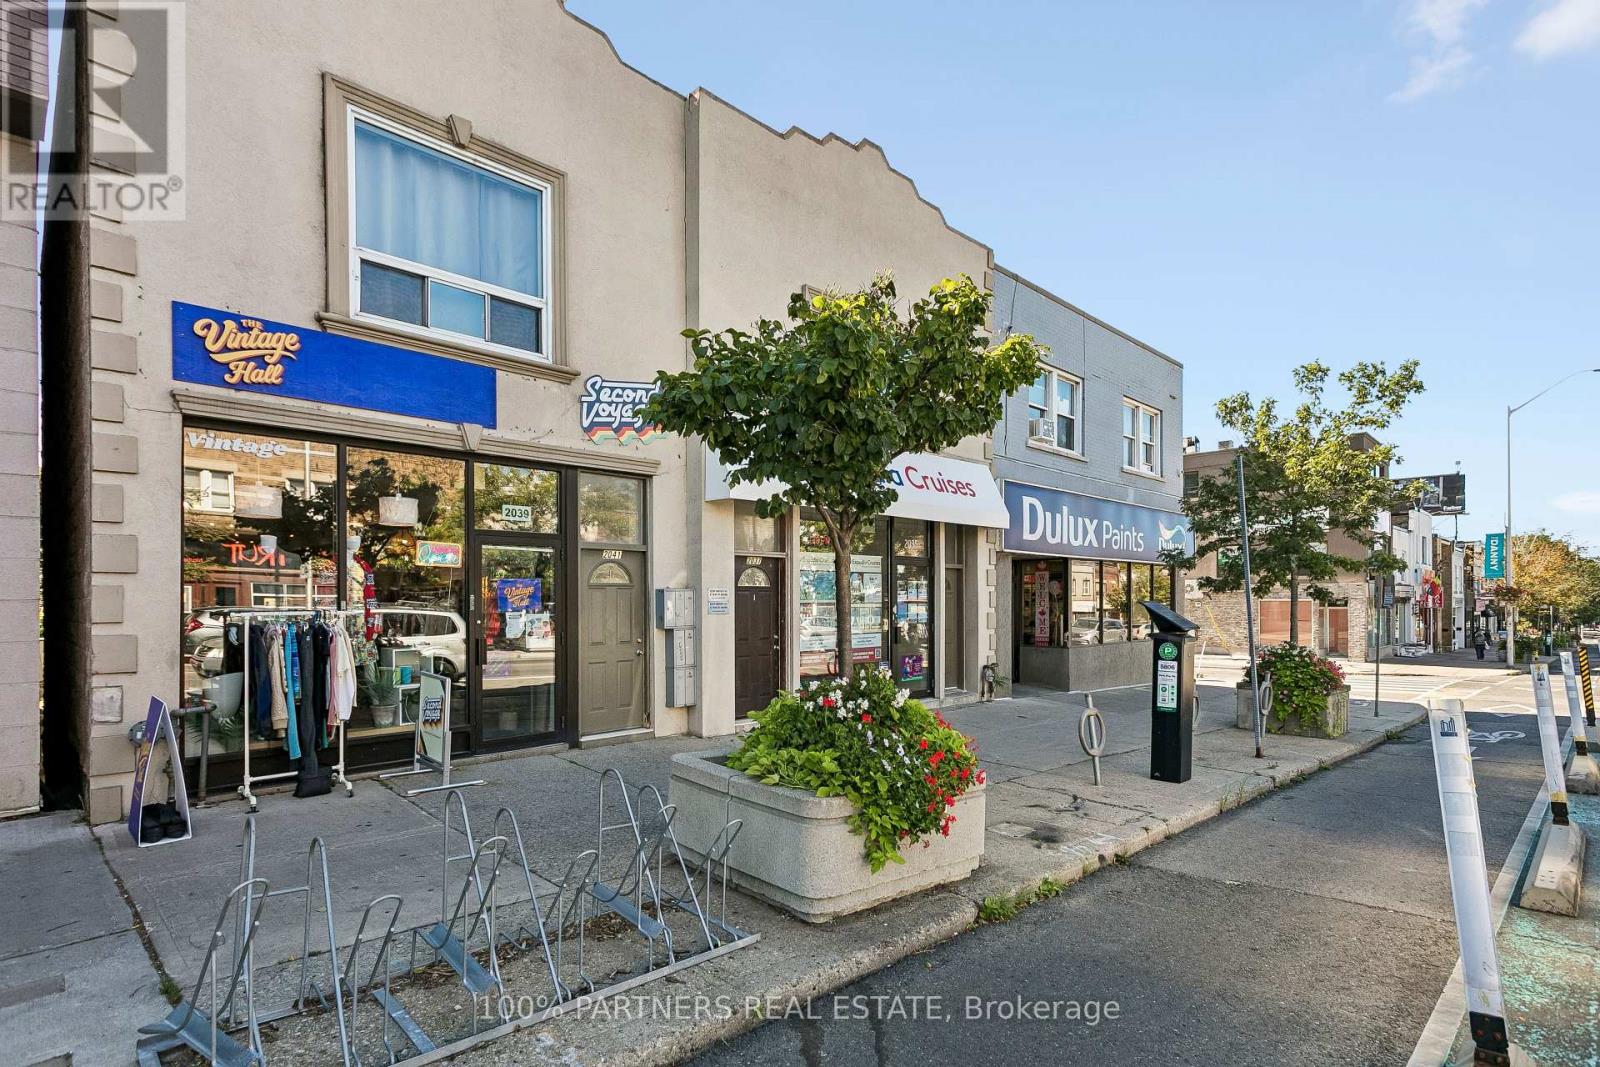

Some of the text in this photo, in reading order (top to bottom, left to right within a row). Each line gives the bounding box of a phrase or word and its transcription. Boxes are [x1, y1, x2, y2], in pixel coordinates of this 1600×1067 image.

[241, 319, 264, 331] THE
[193, 318, 301, 364] Vintage
[223, 361, 285, 385] Hall
[187, 431, 288, 458] Vintage
[904, 465, 976, 498] Cruises
[504, 507, 530, 519] 2039
[1022, 495, 1144, 552] Dulux Paints
